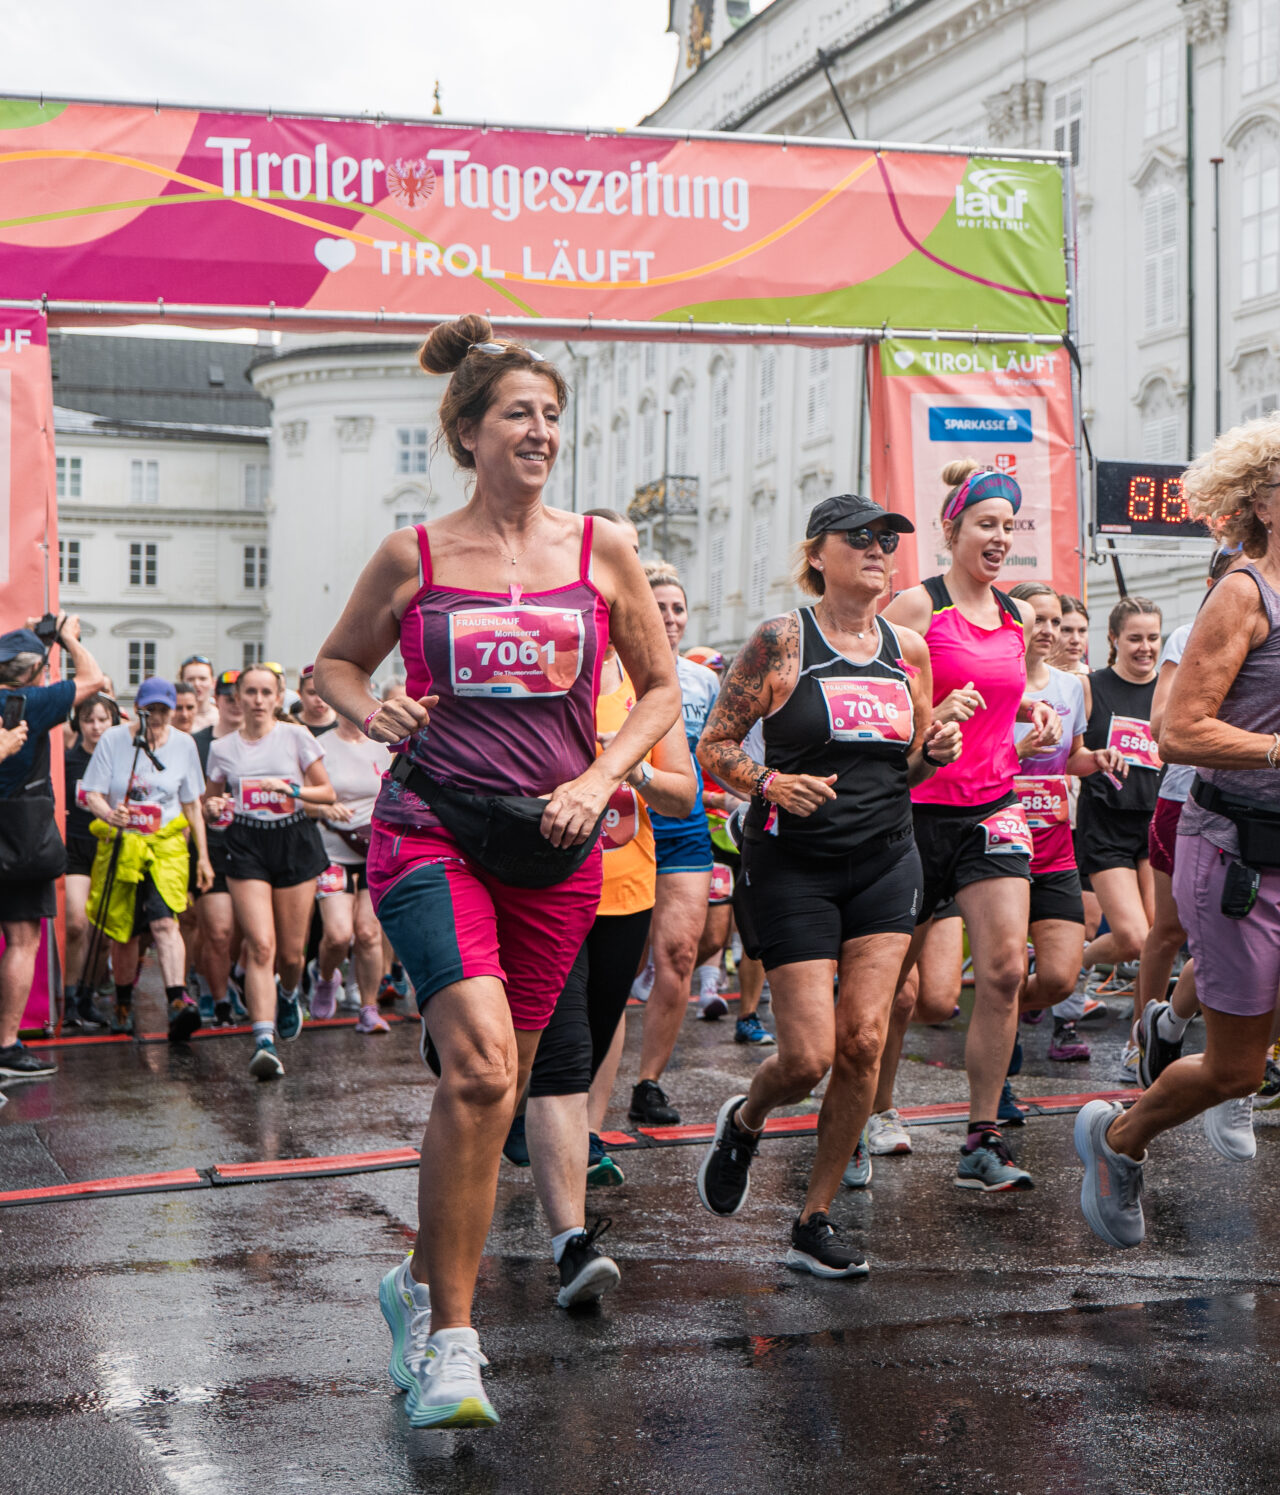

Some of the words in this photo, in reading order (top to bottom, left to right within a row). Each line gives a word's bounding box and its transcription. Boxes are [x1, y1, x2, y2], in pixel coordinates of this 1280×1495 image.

[205, 136, 385, 204] Tiroler
[427, 149, 750, 232] Tageszeitung
[955, 184, 1028, 219] lauf
[373, 241, 506, 279] TIROL
[523, 239, 655, 284] LÄUFT
[921, 351, 985, 372] TIROL
[992, 350, 1057, 374] LÄUFT
[944, 418, 1005, 430] SPARKASSE
[456, 617, 520, 627] FRAUENLAUF
[476, 640, 555, 666] 7061
[843, 700, 899, 719] 7016
[1021, 795, 1061, 811] 5832
